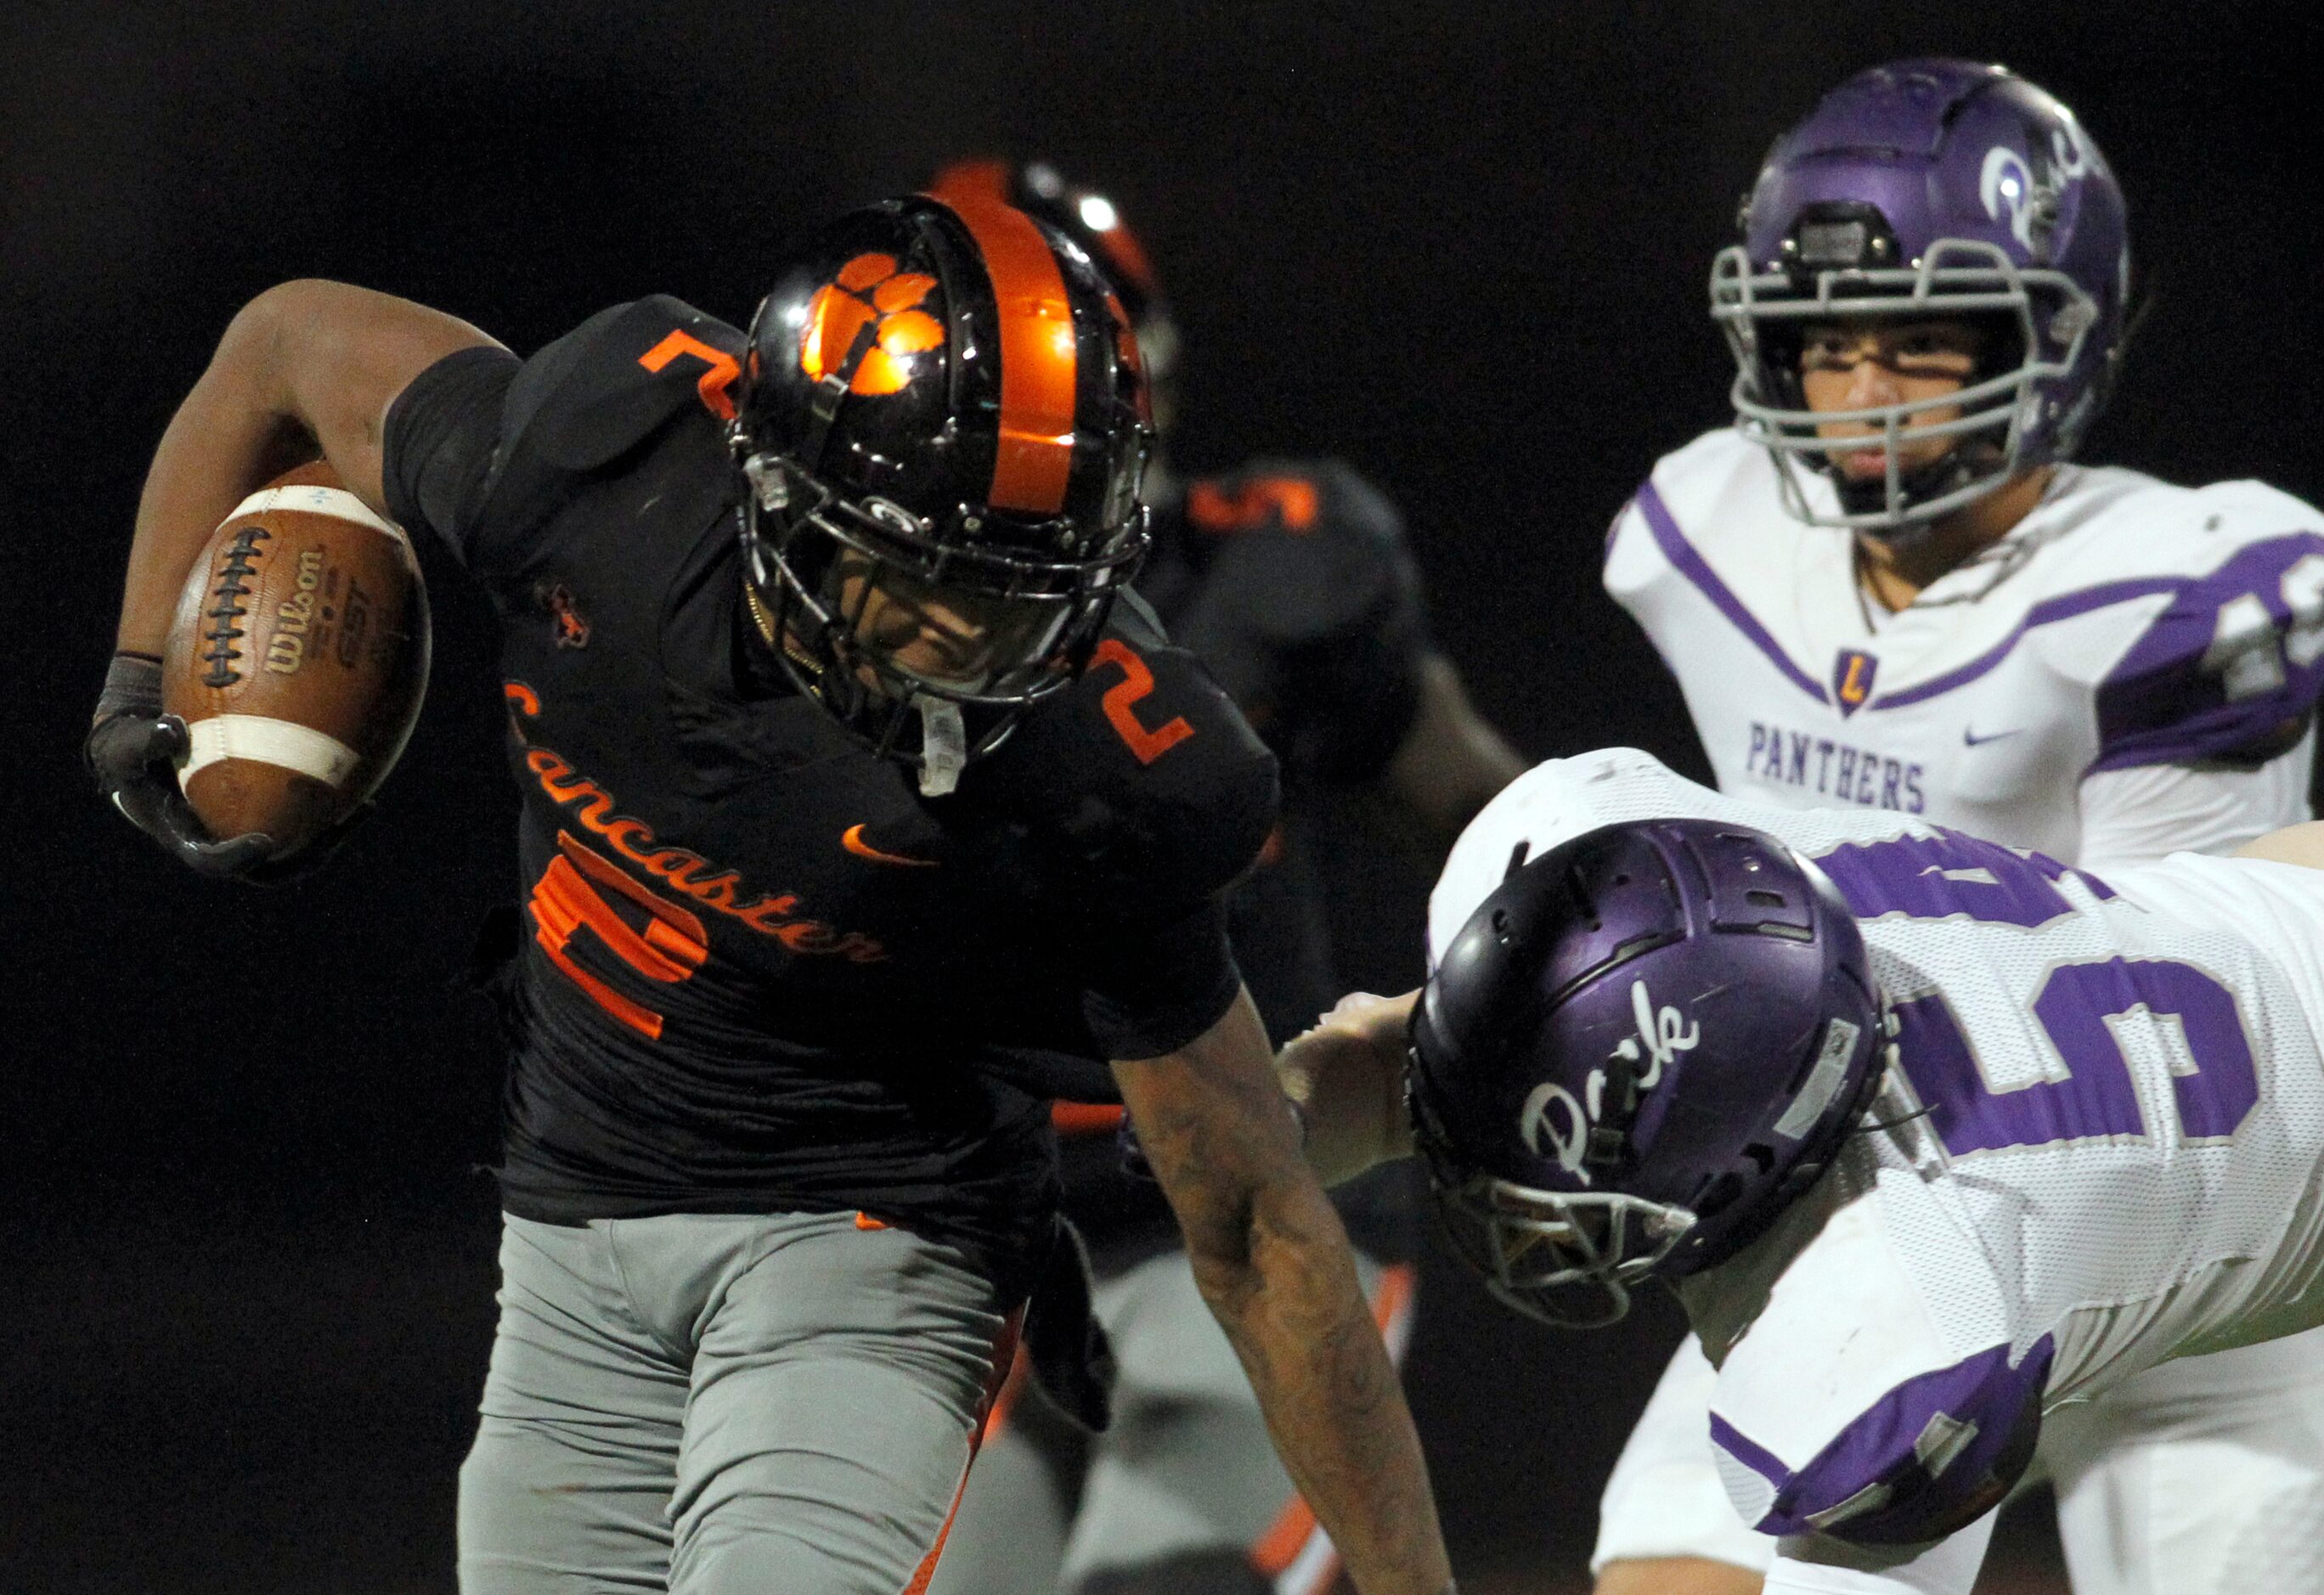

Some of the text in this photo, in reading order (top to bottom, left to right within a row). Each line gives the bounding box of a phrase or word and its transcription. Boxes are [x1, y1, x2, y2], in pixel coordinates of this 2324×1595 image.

[265, 550, 324, 675] Wilson
[1090, 639, 1193, 765] 2
[1840, 655, 1866, 703] L
[1747, 721, 1925, 814] PANTHERS
